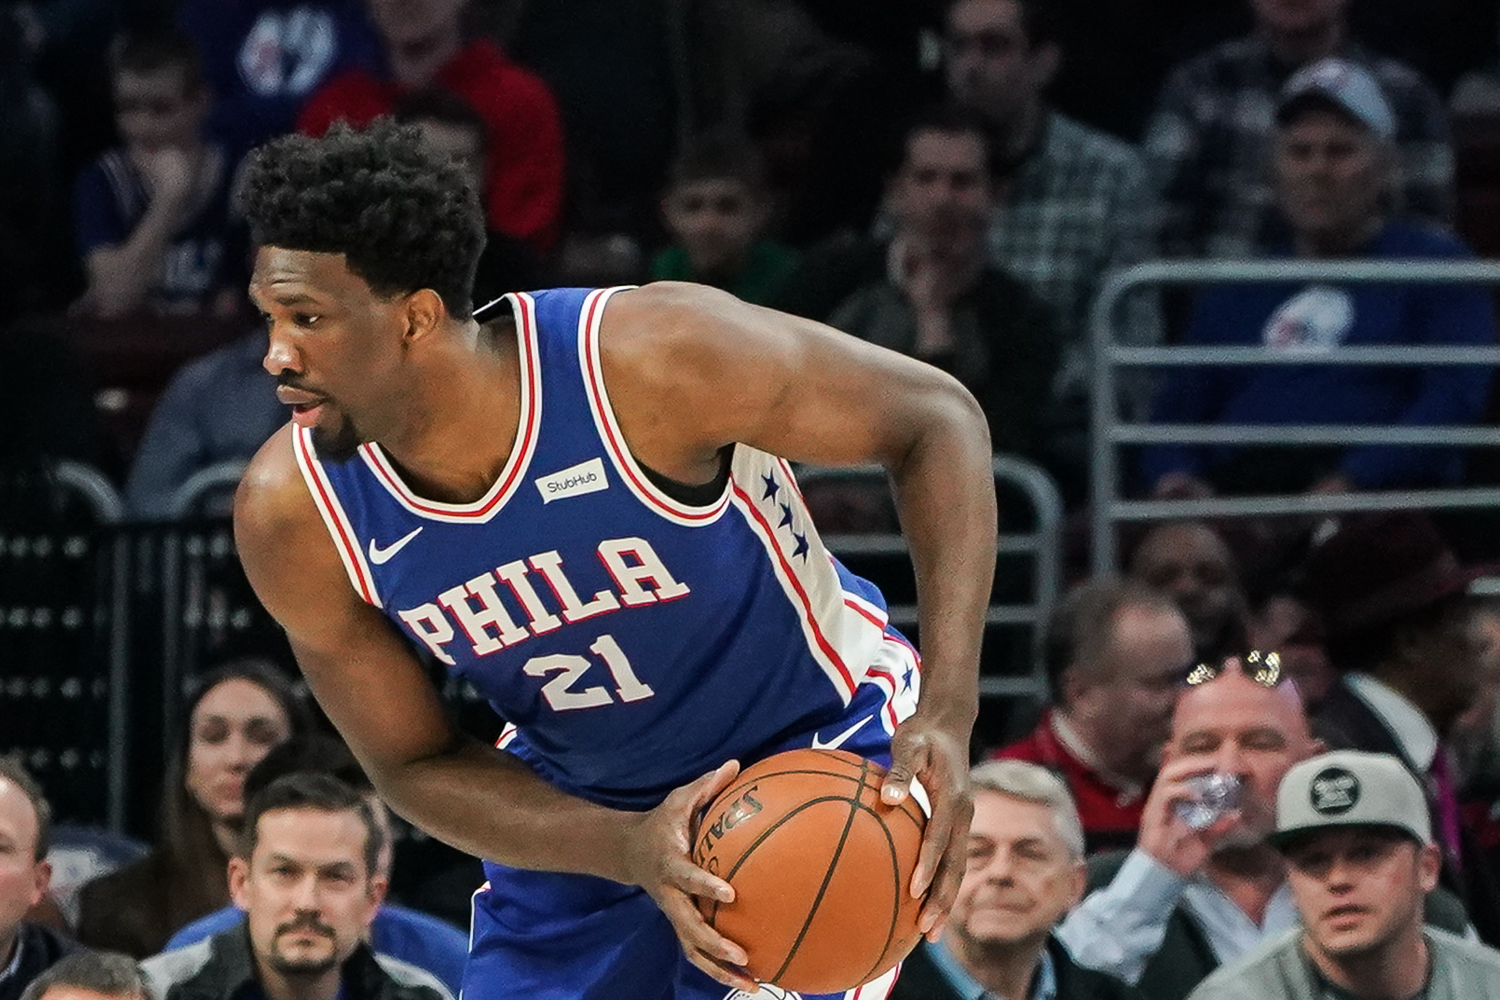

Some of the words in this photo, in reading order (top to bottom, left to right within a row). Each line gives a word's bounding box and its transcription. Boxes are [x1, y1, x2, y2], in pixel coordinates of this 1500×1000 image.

[546, 472, 598, 493] StubHub
[396, 536, 692, 668] PHILA
[521, 634, 656, 712] 21
